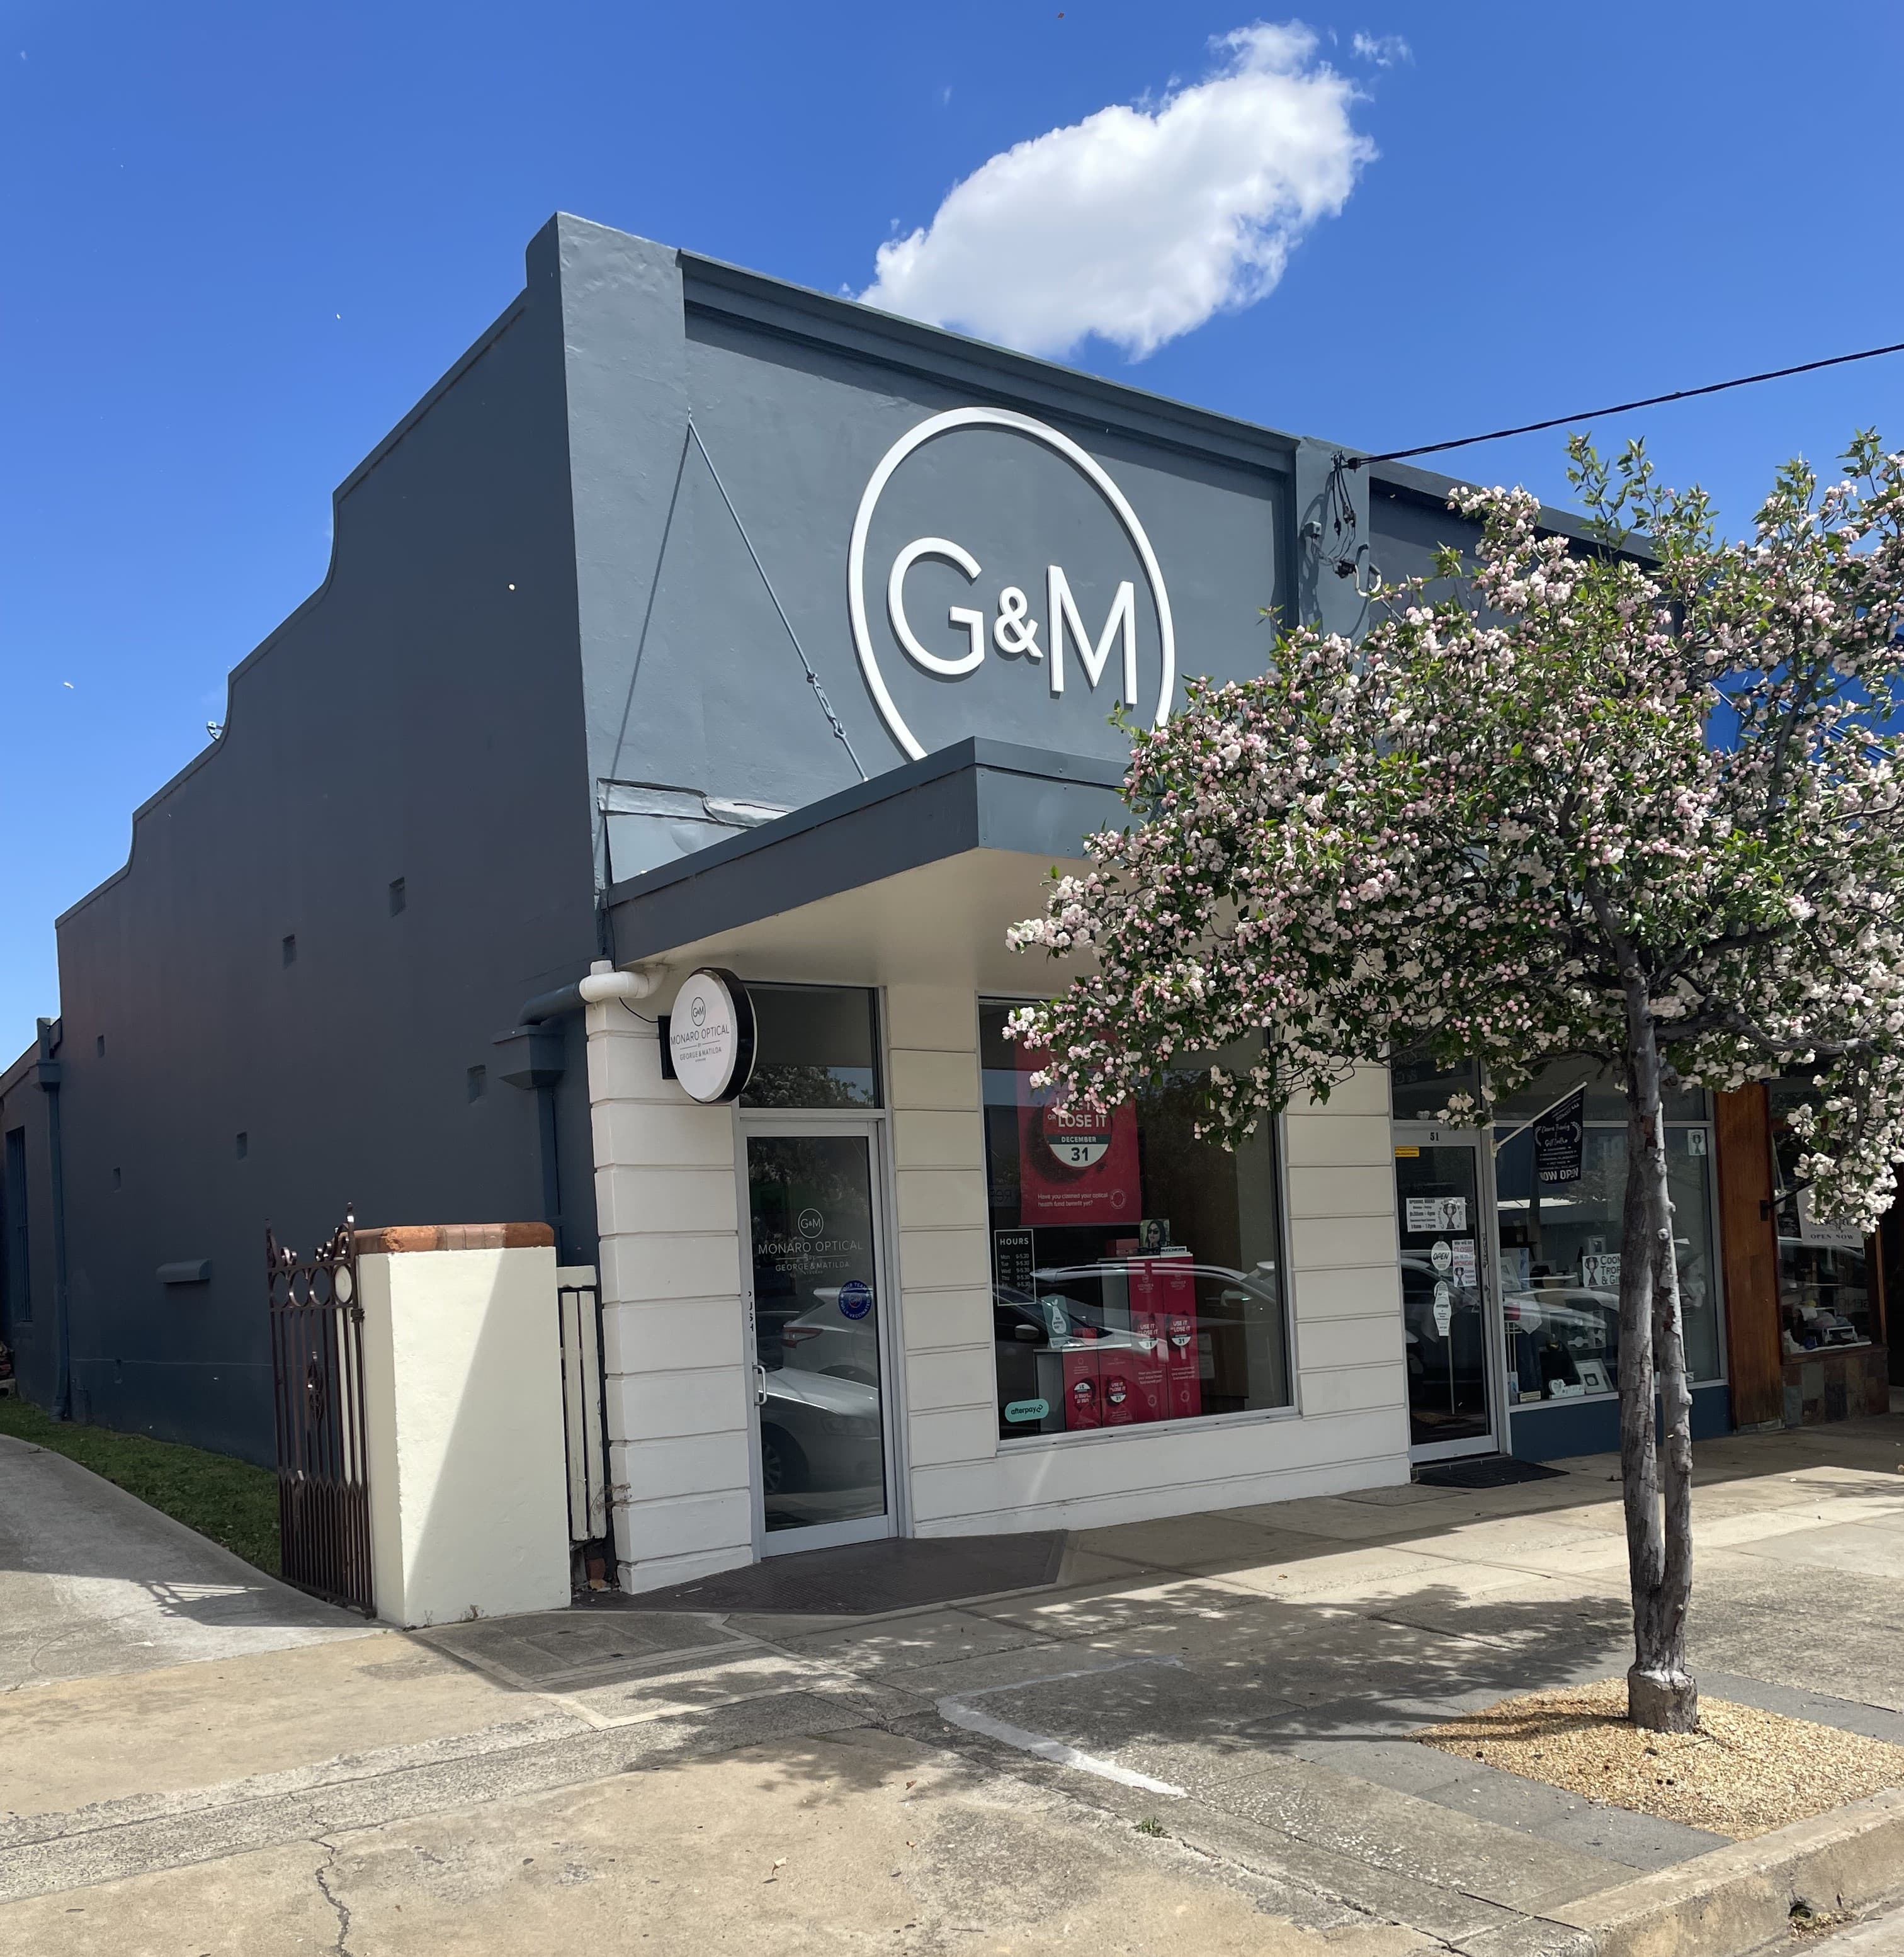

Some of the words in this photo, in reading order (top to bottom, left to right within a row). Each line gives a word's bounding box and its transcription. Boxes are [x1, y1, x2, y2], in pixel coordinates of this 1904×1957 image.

[888, 537, 1137, 705] G&M
[671, 1030, 699, 1045] MONARO
[701, 1024, 730, 1039] OPTICAL
[680, 1051, 698, 1061] GEORGE
[702, 1047, 722, 1055] MATILDA
[1058, 1114, 1092, 1128] LOSE
[1096, 1115, 1106, 1128] IT
[1430, 1132, 1439, 1141] 51
[1071, 1147, 1089, 1161] 31
[800, 1218, 821, 1229] G&M
[759, 1242, 811, 1254] MONARO
[815, 1240, 864, 1252] OPTICAL
[775, 1262, 808, 1272] GEORGE
[816, 1261, 849, 1269] MATILDA
[1601, 1266, 1622, 1275] TROP
[1609, 1275, 1619, 1284] GI
[843, 1283, 853, 1291] OUR
[841, 1300, 849, 1315] FULLY
[849, 1300, 871, 1319] VACCINATED
[1011, 1405, 1036, 1416] afterpay
